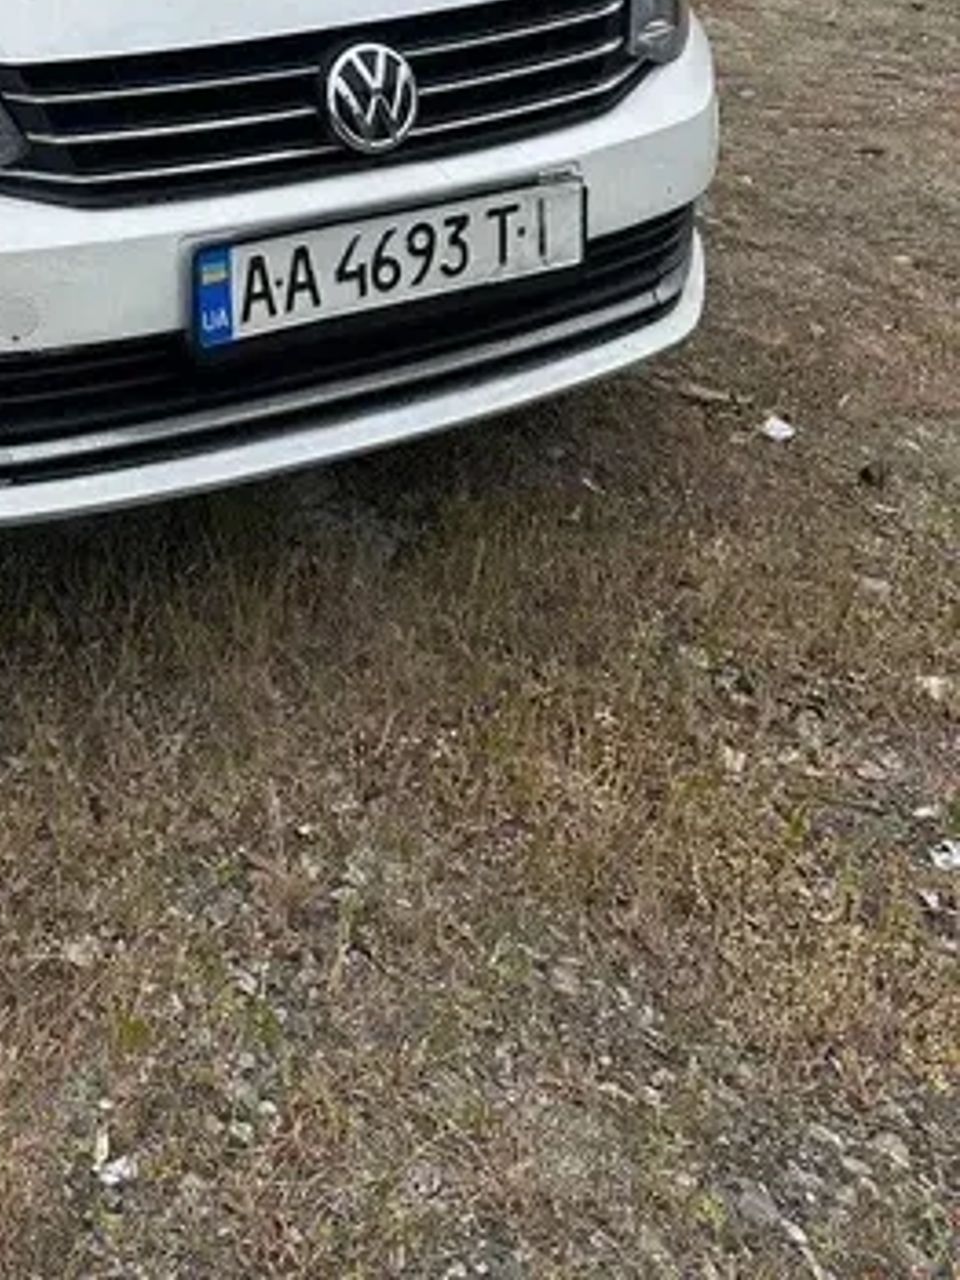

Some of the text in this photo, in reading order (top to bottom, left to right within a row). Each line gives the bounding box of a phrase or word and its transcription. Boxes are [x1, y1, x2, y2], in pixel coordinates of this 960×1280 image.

[242, 245, 321, 322] AA
[335, 215, 469, 298] 4693
[201, 307, 229, 331] UA
